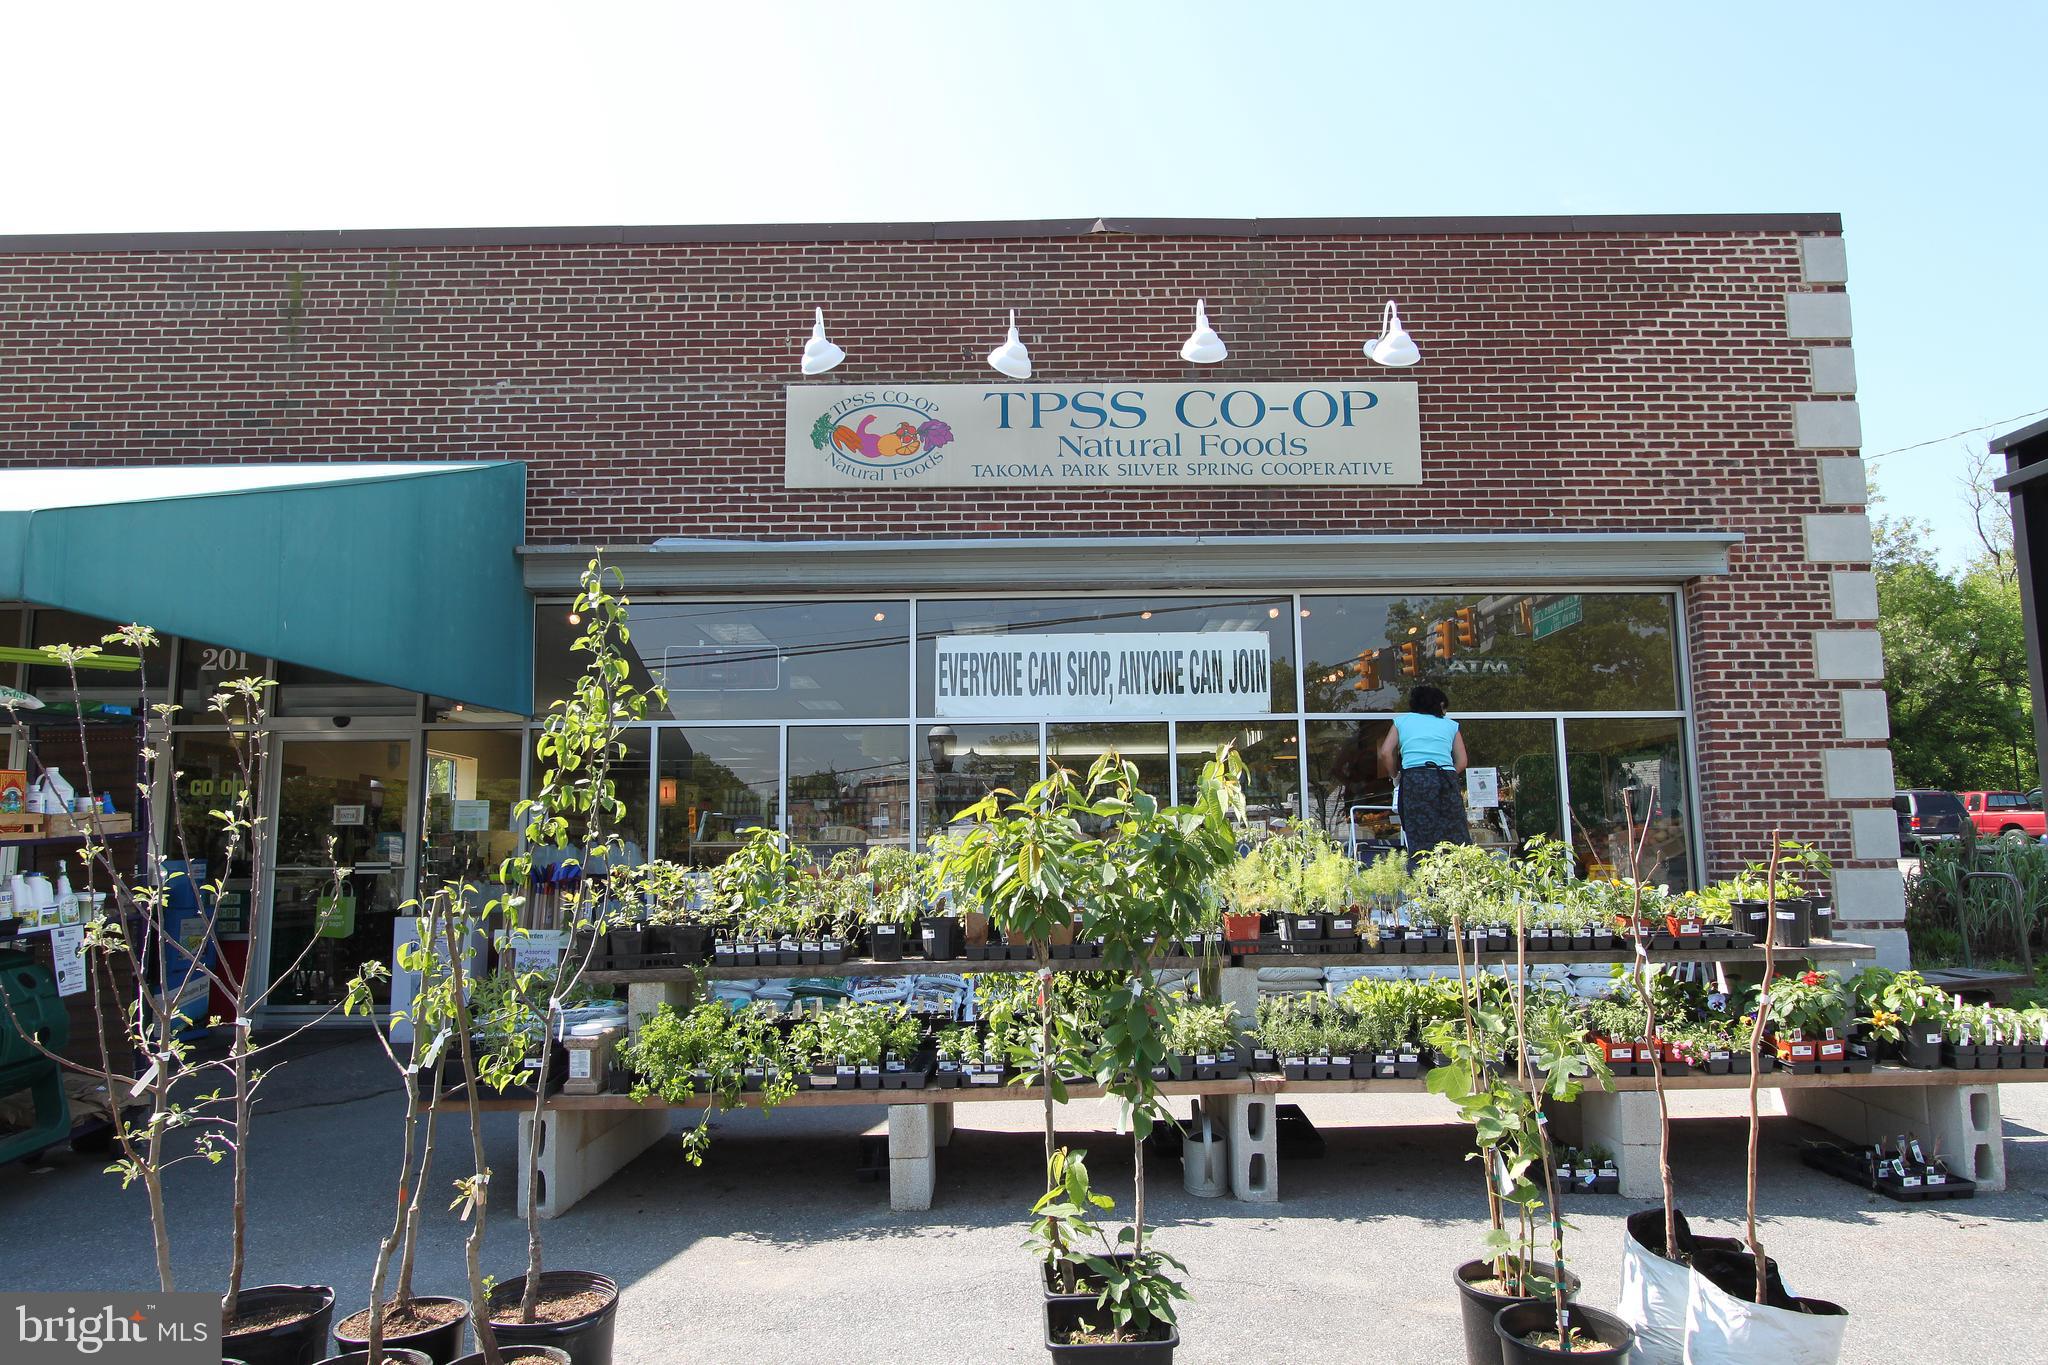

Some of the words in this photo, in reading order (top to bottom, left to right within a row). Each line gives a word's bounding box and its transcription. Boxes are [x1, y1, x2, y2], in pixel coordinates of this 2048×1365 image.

[830, 391, 876, 415] TPSS
[882, 390, 939, 413] CO-OP
[984, 390, 1147, 430] TPSS
[1175, 390, 1378, 429] CO-OP
[1057, 432, 1183, 458] Natural
[1199, 431, 1308, 457] Foods
[825, 452, 884, 481] Natural
[893, 451, 944, 481] Foods
[971, 464, 1054, 478] TAKOMA
[1062, 464, 1110, 477] PARK
[1117, 463, 1179, 477] SILVER
[1187, 462, 1253, 476] SPRING
[1261, 462, 1394, 476] COOPERATIVE
[200, 648, 249, 671] 201
[1448, 660, 1510, 673] ATM
[939, 651, 1023, 697] EVERYONE
[1028, 651, 1061, 697] CAN
[1067, 650, 1113, 705] SHOP,
[1118, 650, 1185, 696] ANYONE
[1189, 649, 1223, 695] CAN
[1228, 648, 1267, 694] JOIN
